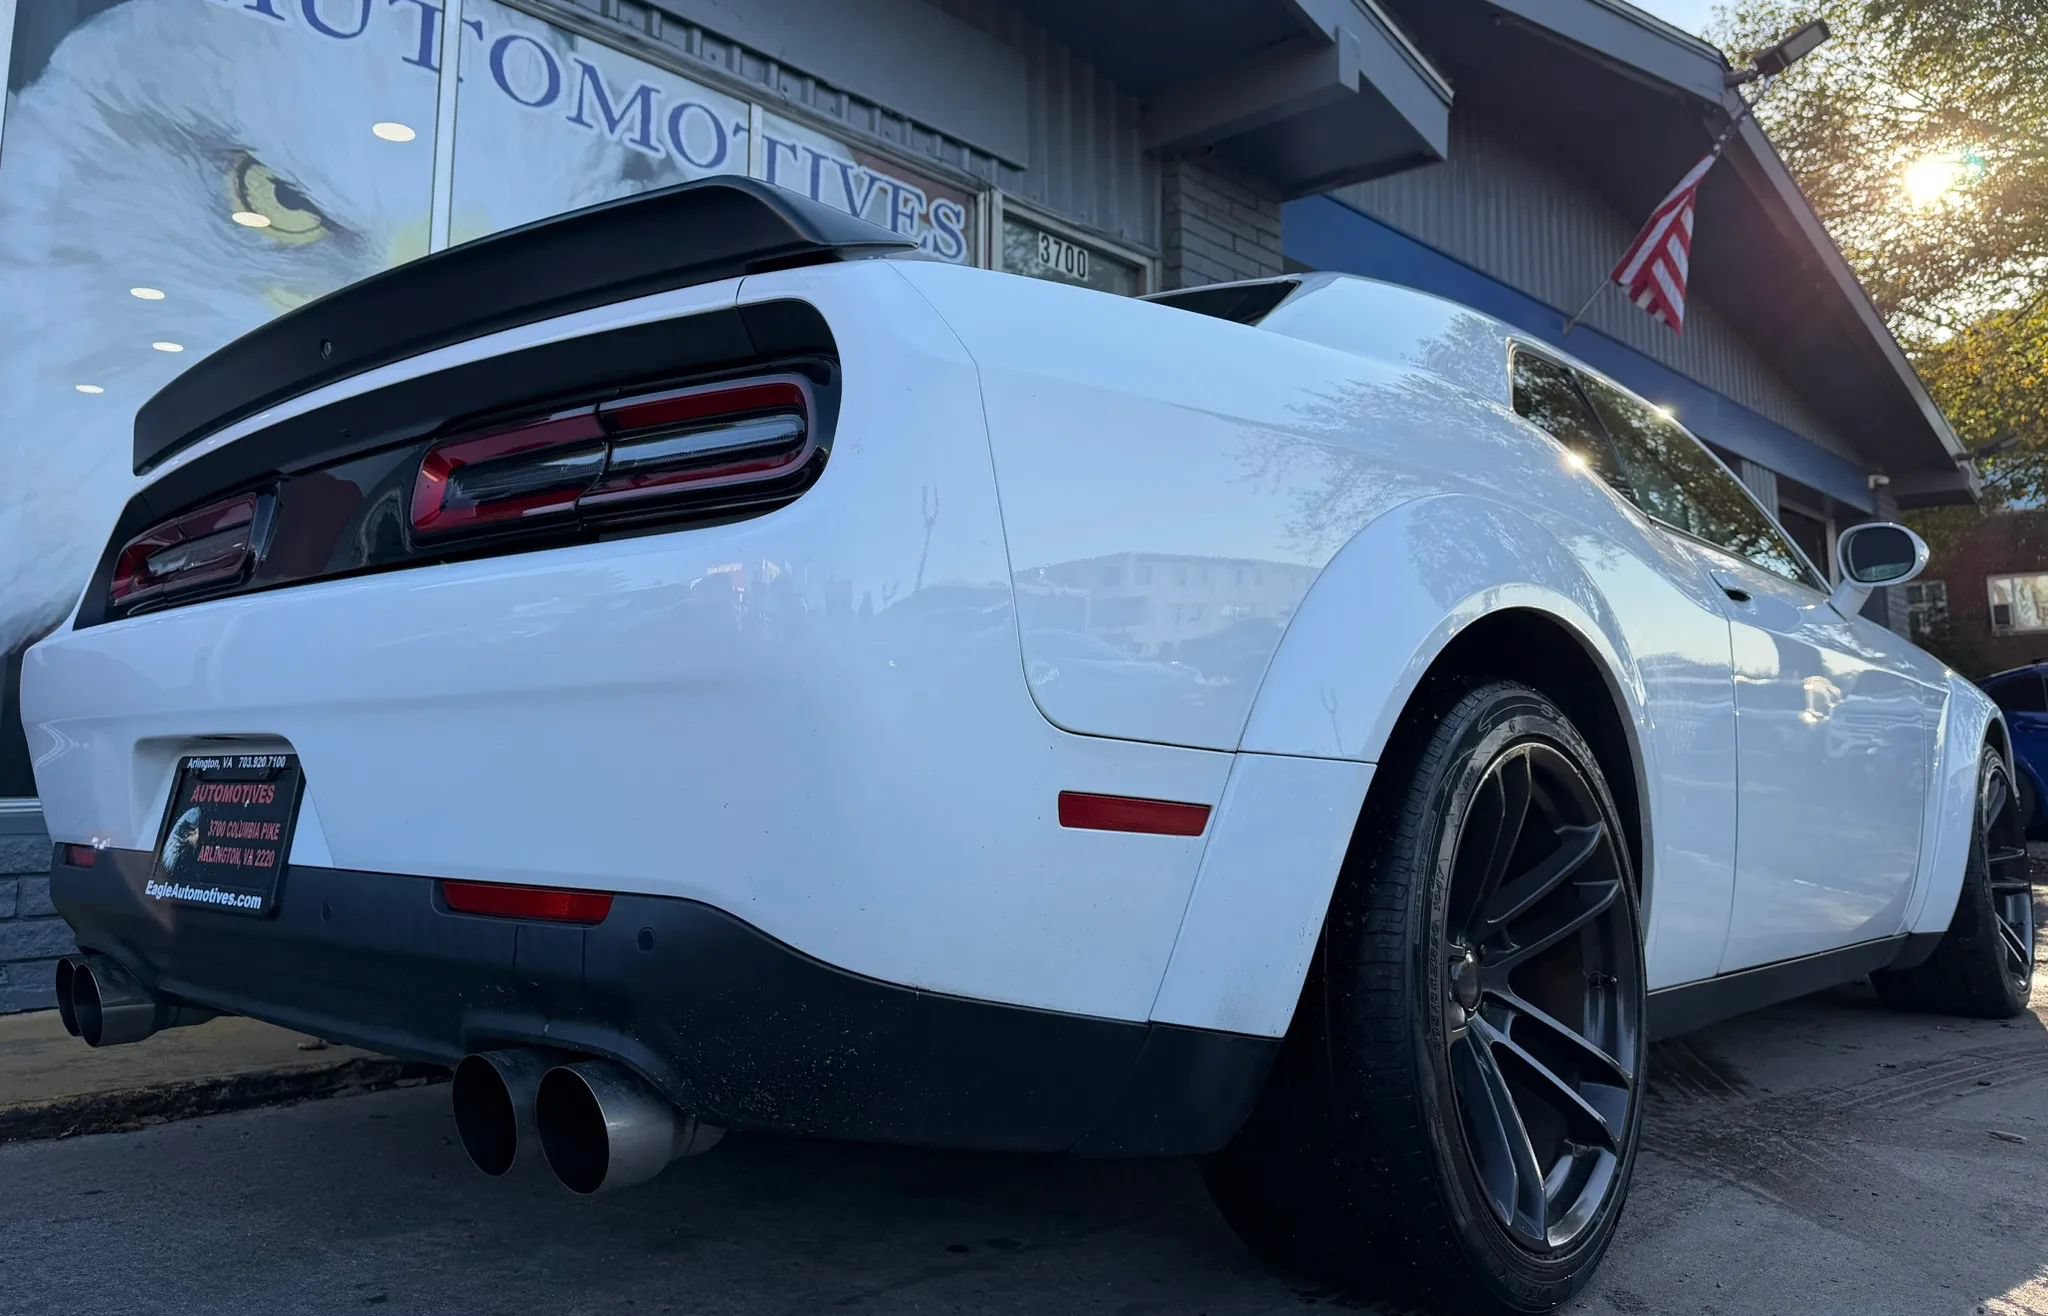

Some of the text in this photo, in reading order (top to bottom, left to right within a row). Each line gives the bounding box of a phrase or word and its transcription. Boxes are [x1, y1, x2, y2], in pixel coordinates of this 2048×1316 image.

[222, 0, 965, 261] UTOMOTIVES
[1041, 235, 1086, 278] 3700
[187, 756, 286, 771] Arlington, VA 703.920.7100
[190, 784, 276, 804] AUTOMOTIVES
[207, 820, 281, 841] 3700 COLUMBIA PIKE
[243, 848, 254, 866] VA
[254, 849, 275, 868] 2220
[145, 880, 262, 909] EagleAutomotives.com
